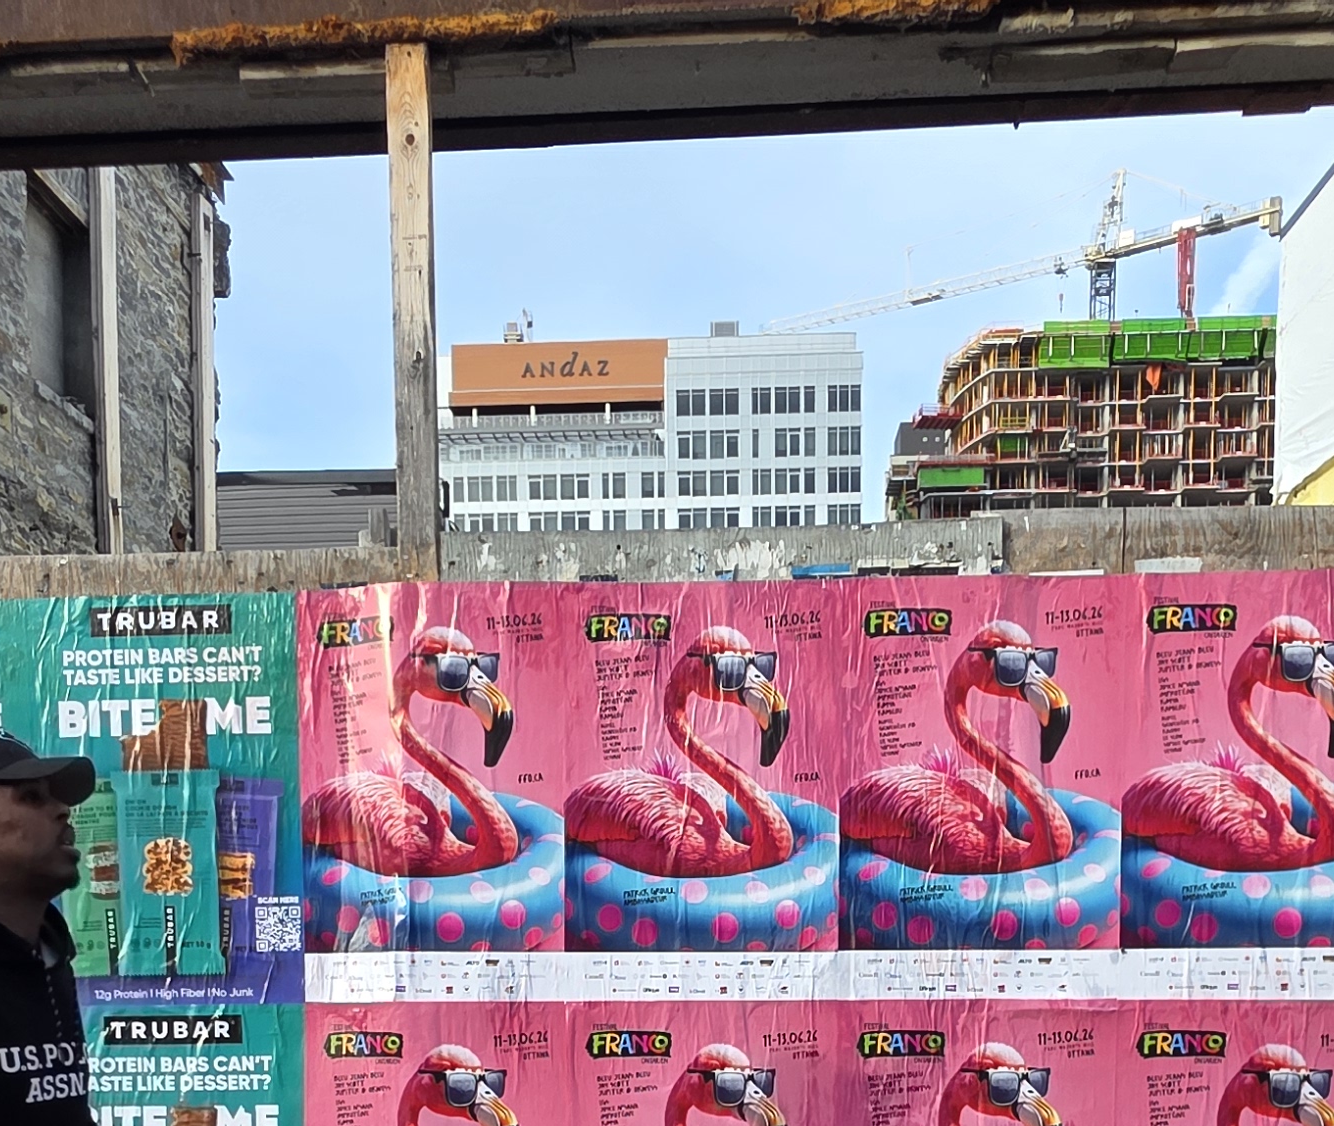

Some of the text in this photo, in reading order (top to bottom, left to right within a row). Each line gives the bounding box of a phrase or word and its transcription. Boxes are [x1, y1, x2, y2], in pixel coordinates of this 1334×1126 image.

[97, 610, 219, 631] TRUBAR
[869, 611, 950, 634] FRANCO
[1153, 606, 1232, 631] FRANCO
[62, 646, 262, 667] PROTEIN BARS CAN'T
[63, 665, 262, 686] TASTE LIKE DESSERT?
[58, 696, 272, 738] BITE ME
[107, 911, 116, 949] TRUBAR
[94, 988, 254, 1001] 12g Protein High Fiber No Junk
[110, 1021, 230, 1039] TRUBAR
[493, 1030, 549, 1047] 11-13.06.26
[763, 1030, 818, 1047] 11-13.06.26
[330, 1033, 400, 1057] FRANCO
[592, 1033, 668, 1056] FRANCO
[863, 1032, 942, 1056] FRANCO
[1143, 1032, 1224, 1056] FRANCO
[88, 1055, 272, 1074] ROTEIN BARS CAN'T
[88, 1074, 271, 1092] ASTE LIKE DESSERT?
